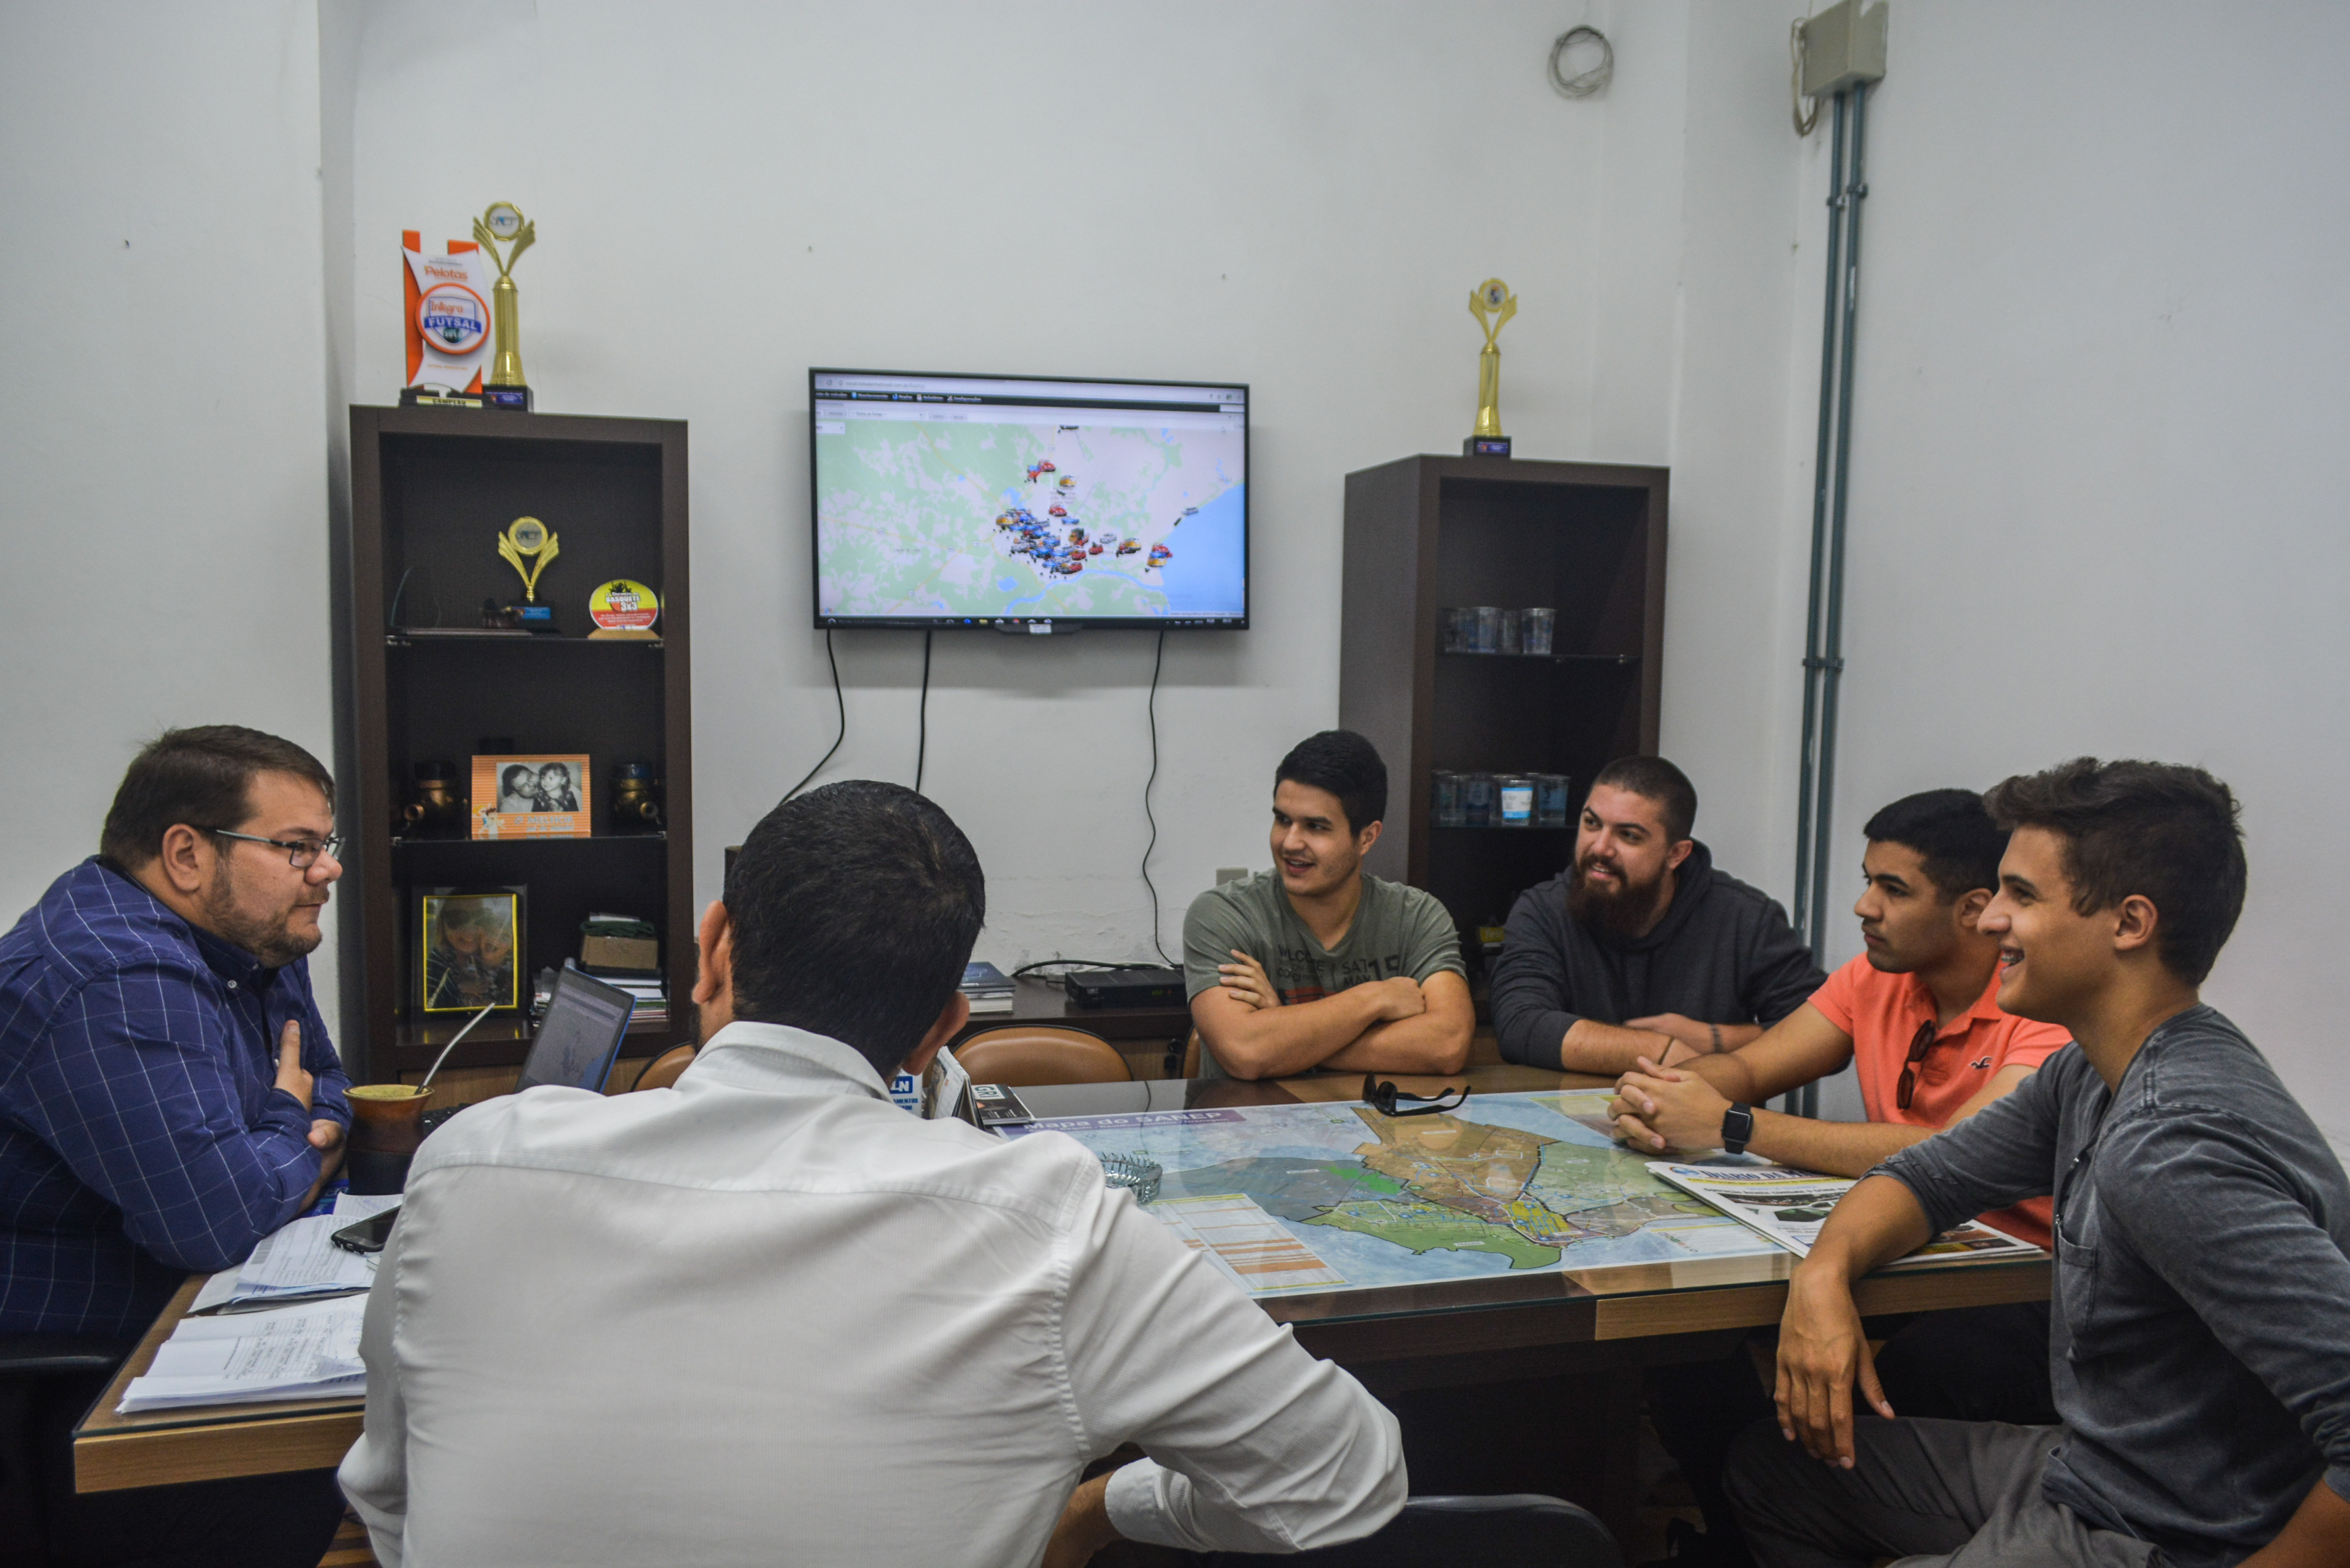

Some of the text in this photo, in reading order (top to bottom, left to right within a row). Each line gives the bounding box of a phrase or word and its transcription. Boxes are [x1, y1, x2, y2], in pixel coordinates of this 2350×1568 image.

[424, 265, 468, 279] Pelotas
[430, 301, 464, 315] Integra
[428, 317, 478, 331] FUTSAL
[620, 602, 638, 612] 3x3
[527, 815, 573, 824] MELHOR
[1023, 1121, 1091, 1129] Mapa
[1135, 1112, 1222, 1123] SANEP
